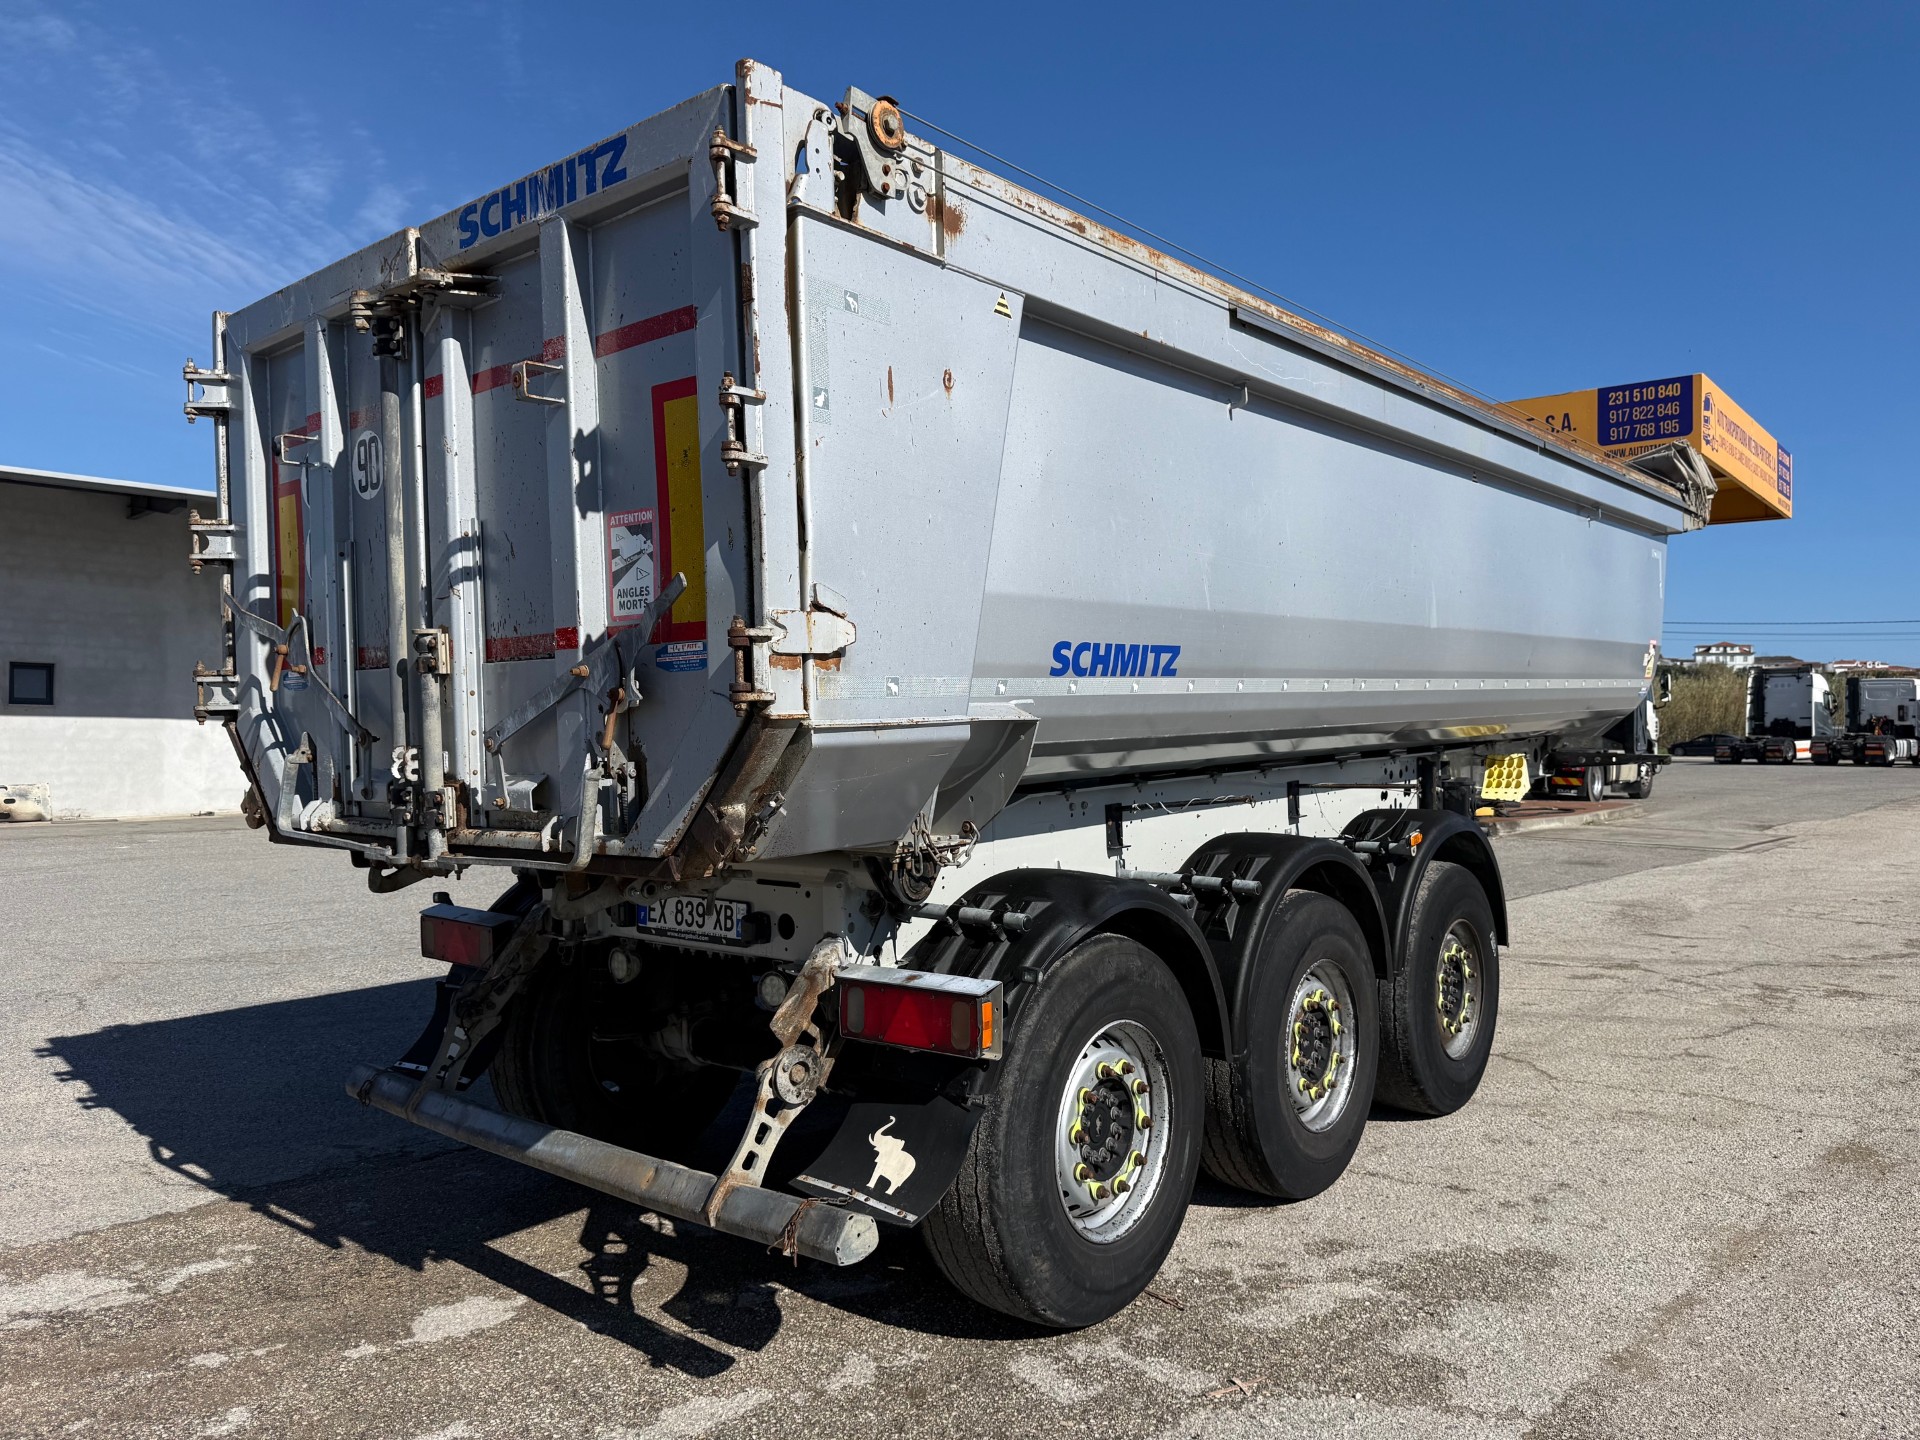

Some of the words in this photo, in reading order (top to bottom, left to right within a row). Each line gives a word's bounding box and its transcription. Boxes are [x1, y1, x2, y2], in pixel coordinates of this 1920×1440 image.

[459, 134, 627, 249] SCHMITZ
[1608, 390, 1630, 406] 231
[1633, 386, 1655, 402] 510
[1658, 383, 1681, 399] 840
[1545, 412, 1577, 433] S.A.
[1609, 408, 1630, 424] 917
[1632, 405, 1655, 421] 822
[1657, 401, 1680, 417] 846
[1610, 425, 1631, 441] 917
[1633, 422, 1655, 438] 768
[1659, 419, 1680, 435] 195
[357, 435, 381, 493] 90
[610, 510, 653, 526] ATTENTION
[616, 585, 650, 600] ANGLES
[618, 598, 649, 611] MORTS
[1049, 640, 1182, 677] SCHMITZ
[647, 899, 668, 925] EX
[674, 899, 706, 929] 839
[713, 903, 735, 932] XB
